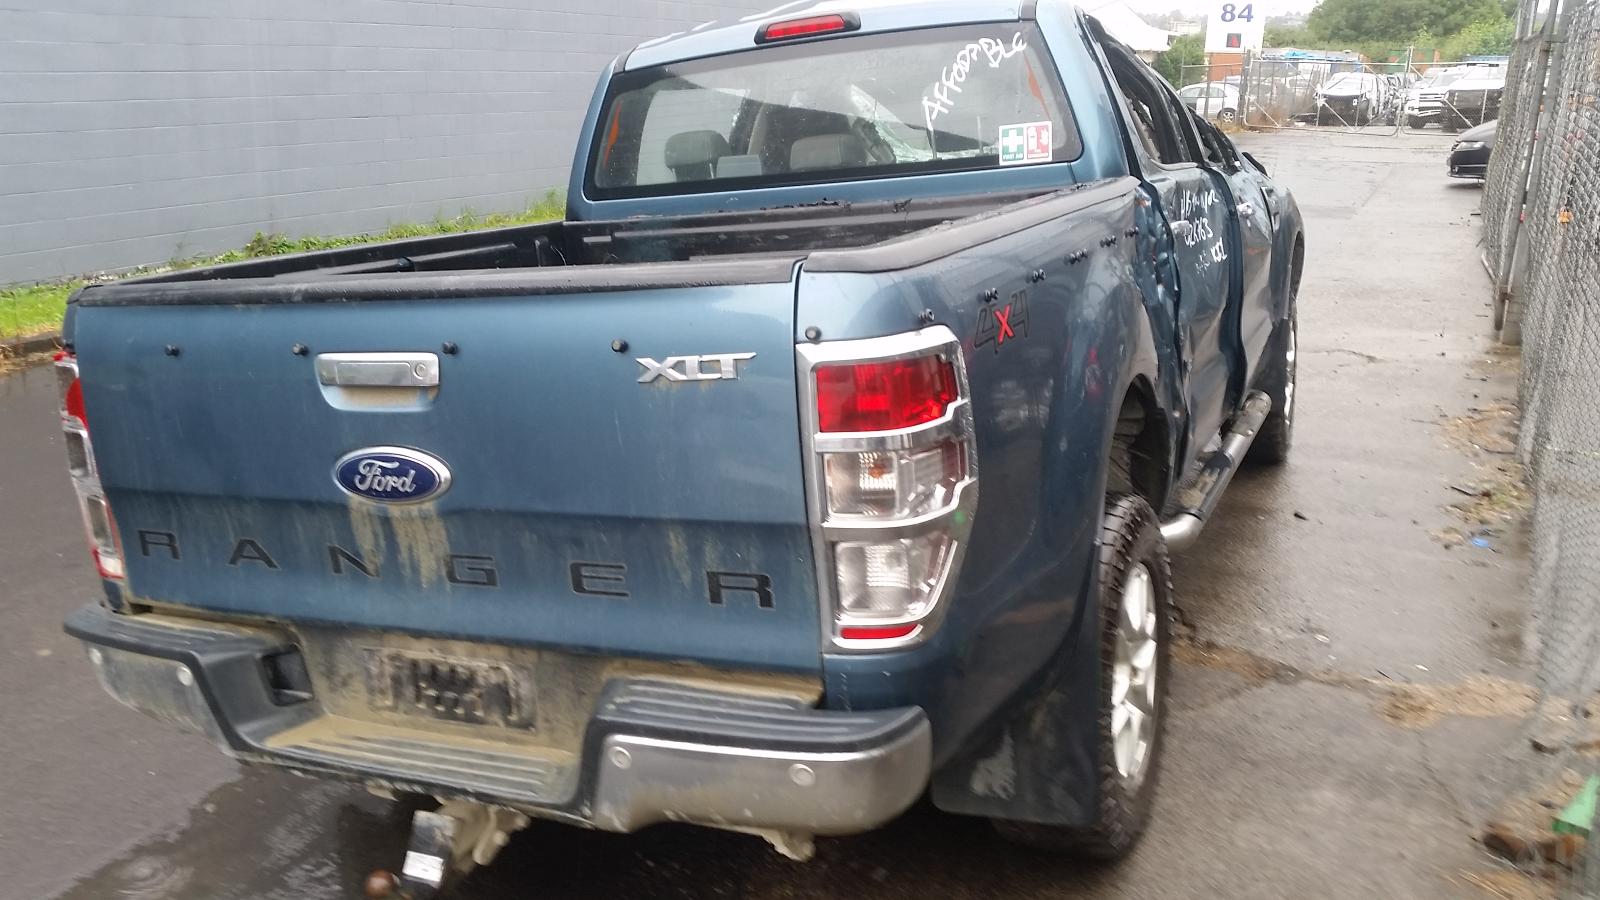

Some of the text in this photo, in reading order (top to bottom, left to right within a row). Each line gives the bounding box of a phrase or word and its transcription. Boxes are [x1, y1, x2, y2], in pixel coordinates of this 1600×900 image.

[1221, 3, 1254, 22] 84
[635, 352, 757, 383] XLT
[354, 458, 416, 494] Ford
[137, 529, 775, 609] RANGER
